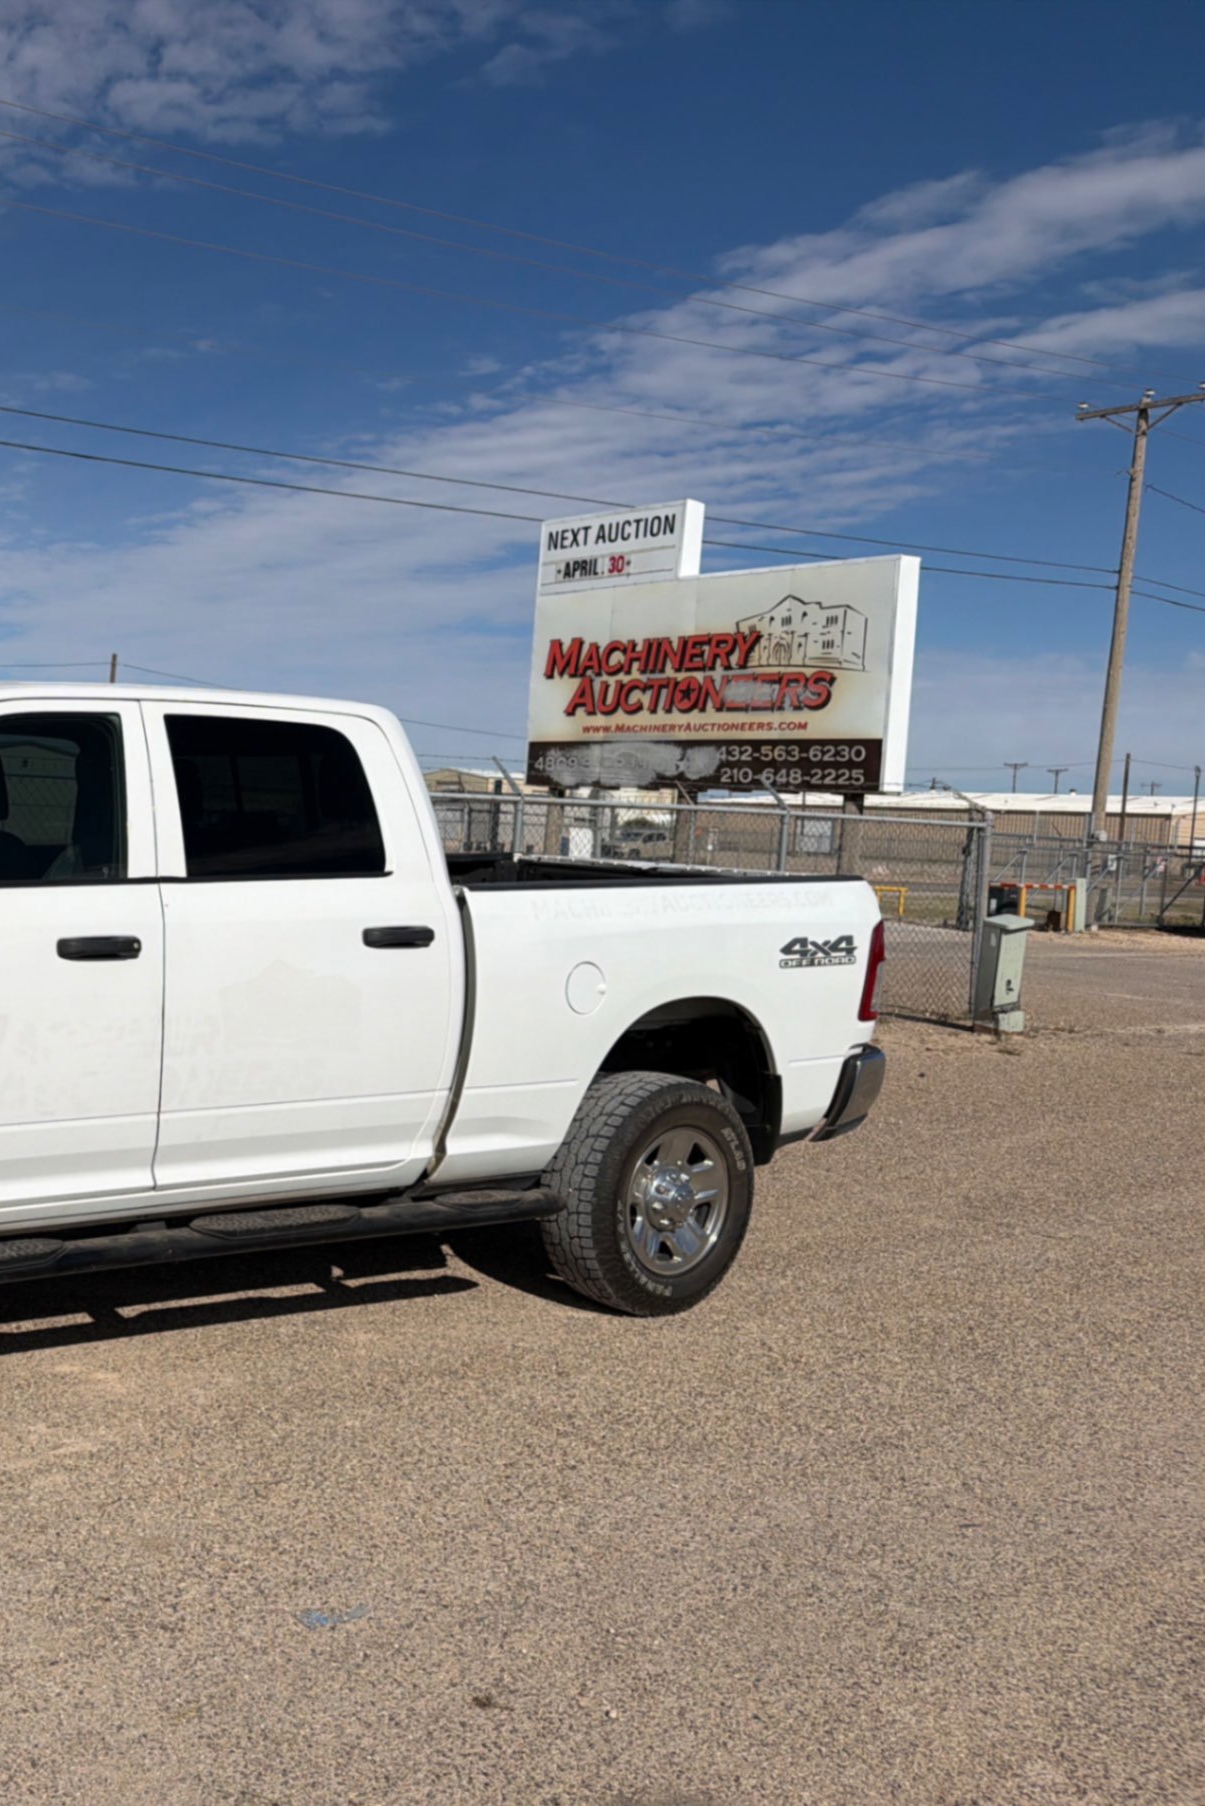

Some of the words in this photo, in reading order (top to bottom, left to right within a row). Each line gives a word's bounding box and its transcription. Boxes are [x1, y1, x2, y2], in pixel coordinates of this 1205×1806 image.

[547, 526, 591, 551] NEXT
[594, 513, 676, 544] AUCTION
[544, 631, 760, 678] MACHINERY
[717, 745, 866, 762] 432-563-6230
[720, 768, 865, 785] 210-648-2225
